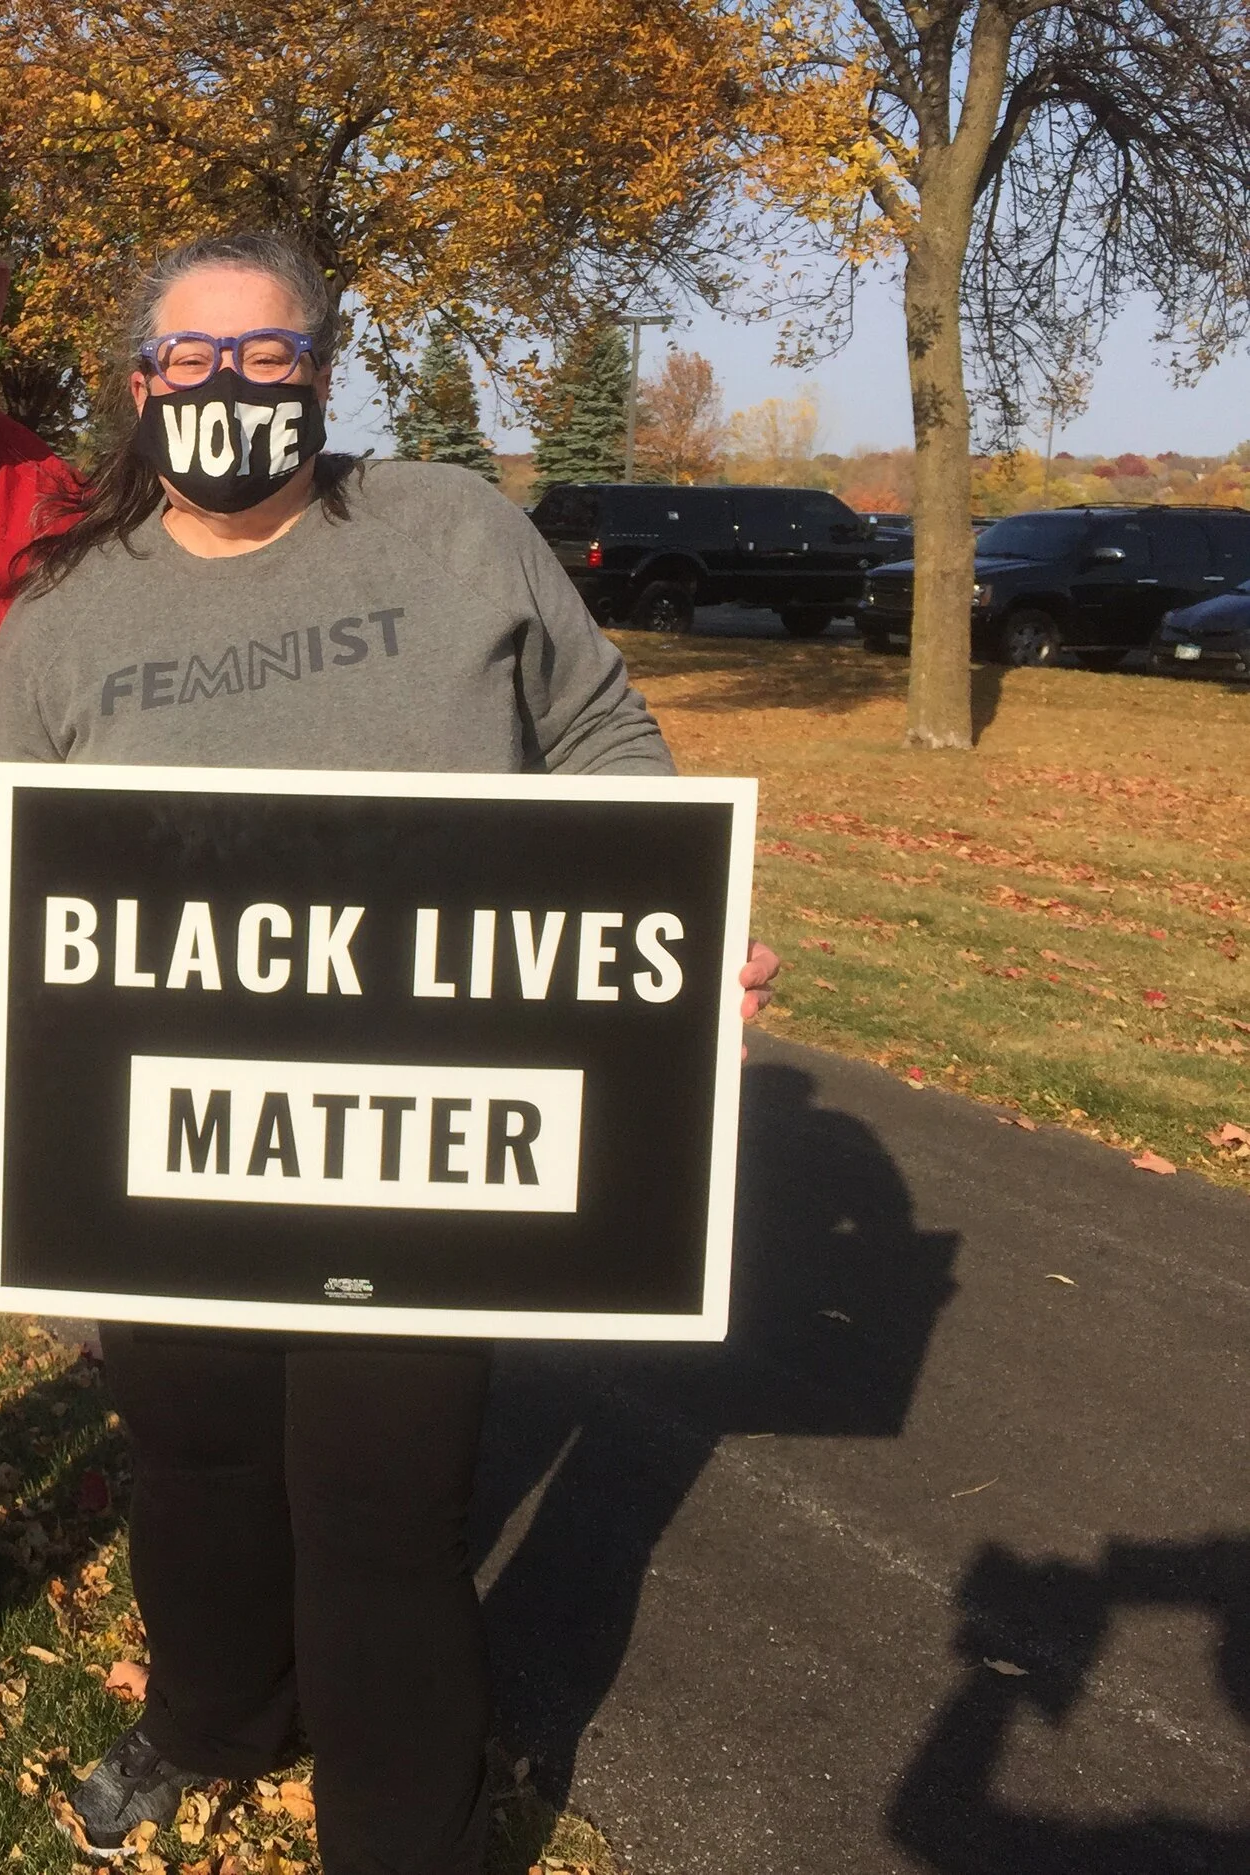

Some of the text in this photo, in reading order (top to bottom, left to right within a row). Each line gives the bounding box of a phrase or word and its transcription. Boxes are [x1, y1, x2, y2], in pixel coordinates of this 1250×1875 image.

[162, 401, 303, 478] VOTE
[101, 607, 405, 716] FEMNIST
[44, 896, 685, 1003] BLACK LIVES
[166, 1087, 542, 1186] MATTER
